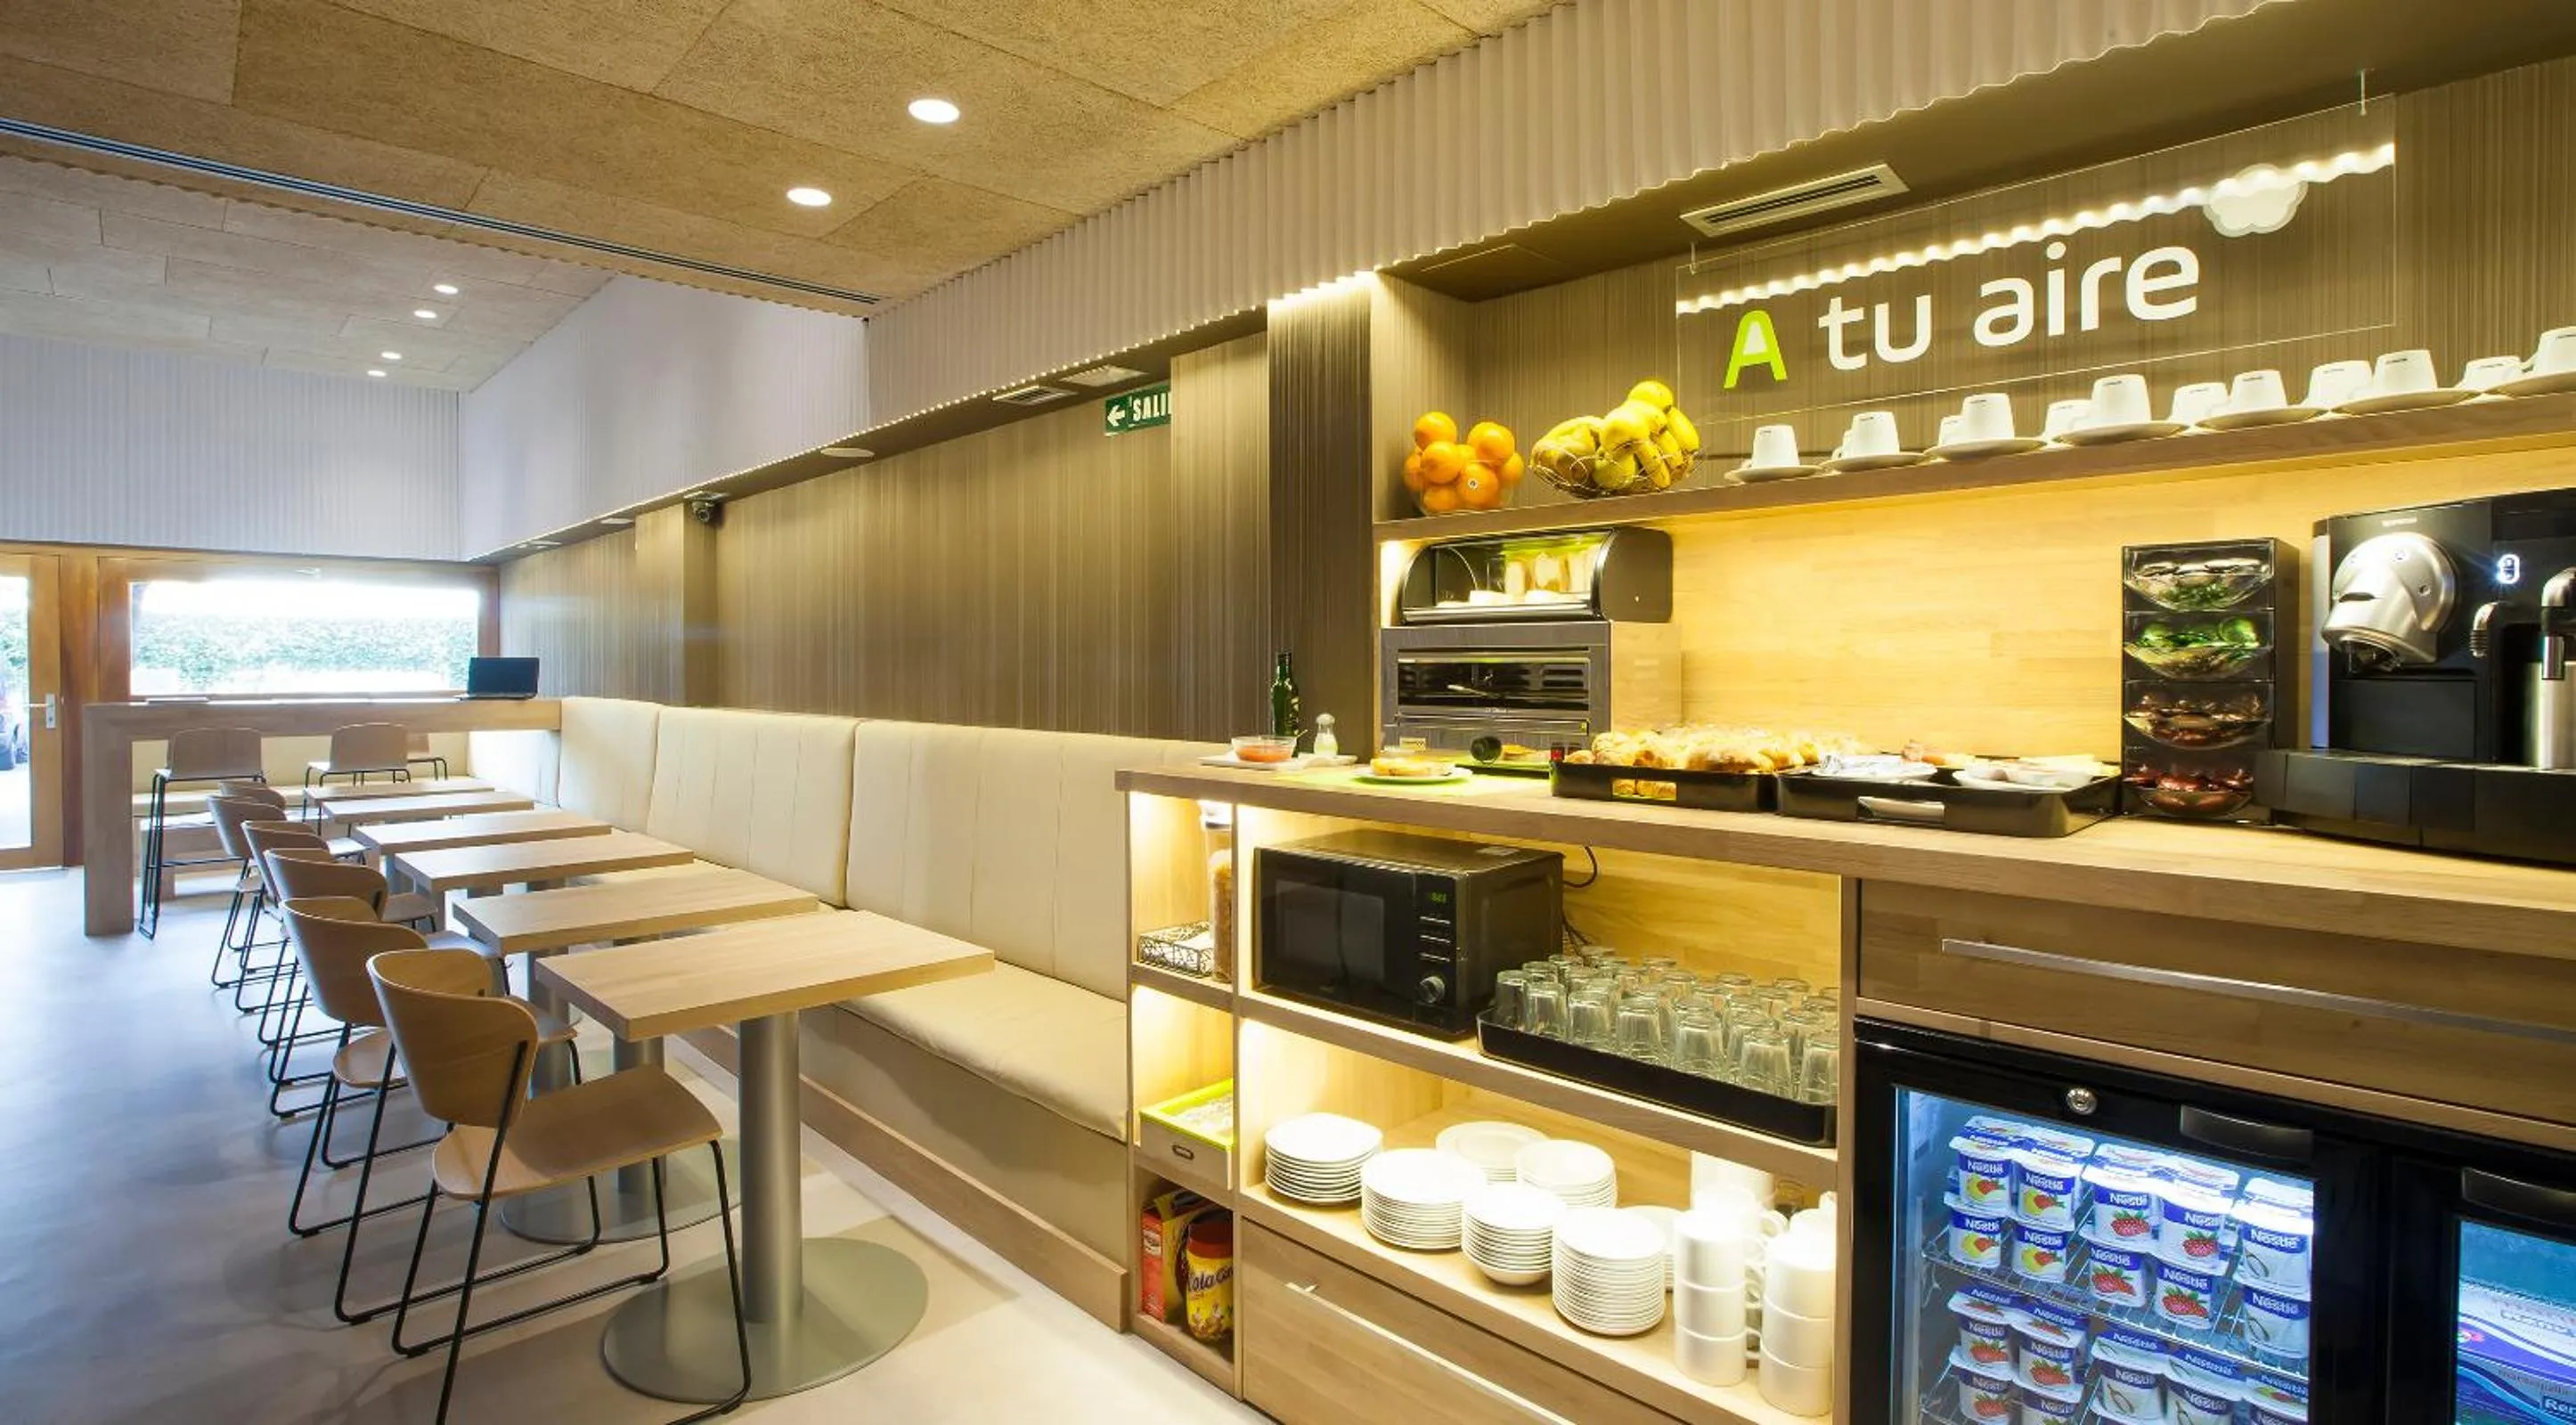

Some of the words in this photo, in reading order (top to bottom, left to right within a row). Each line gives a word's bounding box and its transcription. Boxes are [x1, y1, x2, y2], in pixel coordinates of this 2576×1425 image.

[1724, 311, 1787, 388] A
[1818, 295, 1932, 370] tu
[1973, 241, 2199, 346] aire
